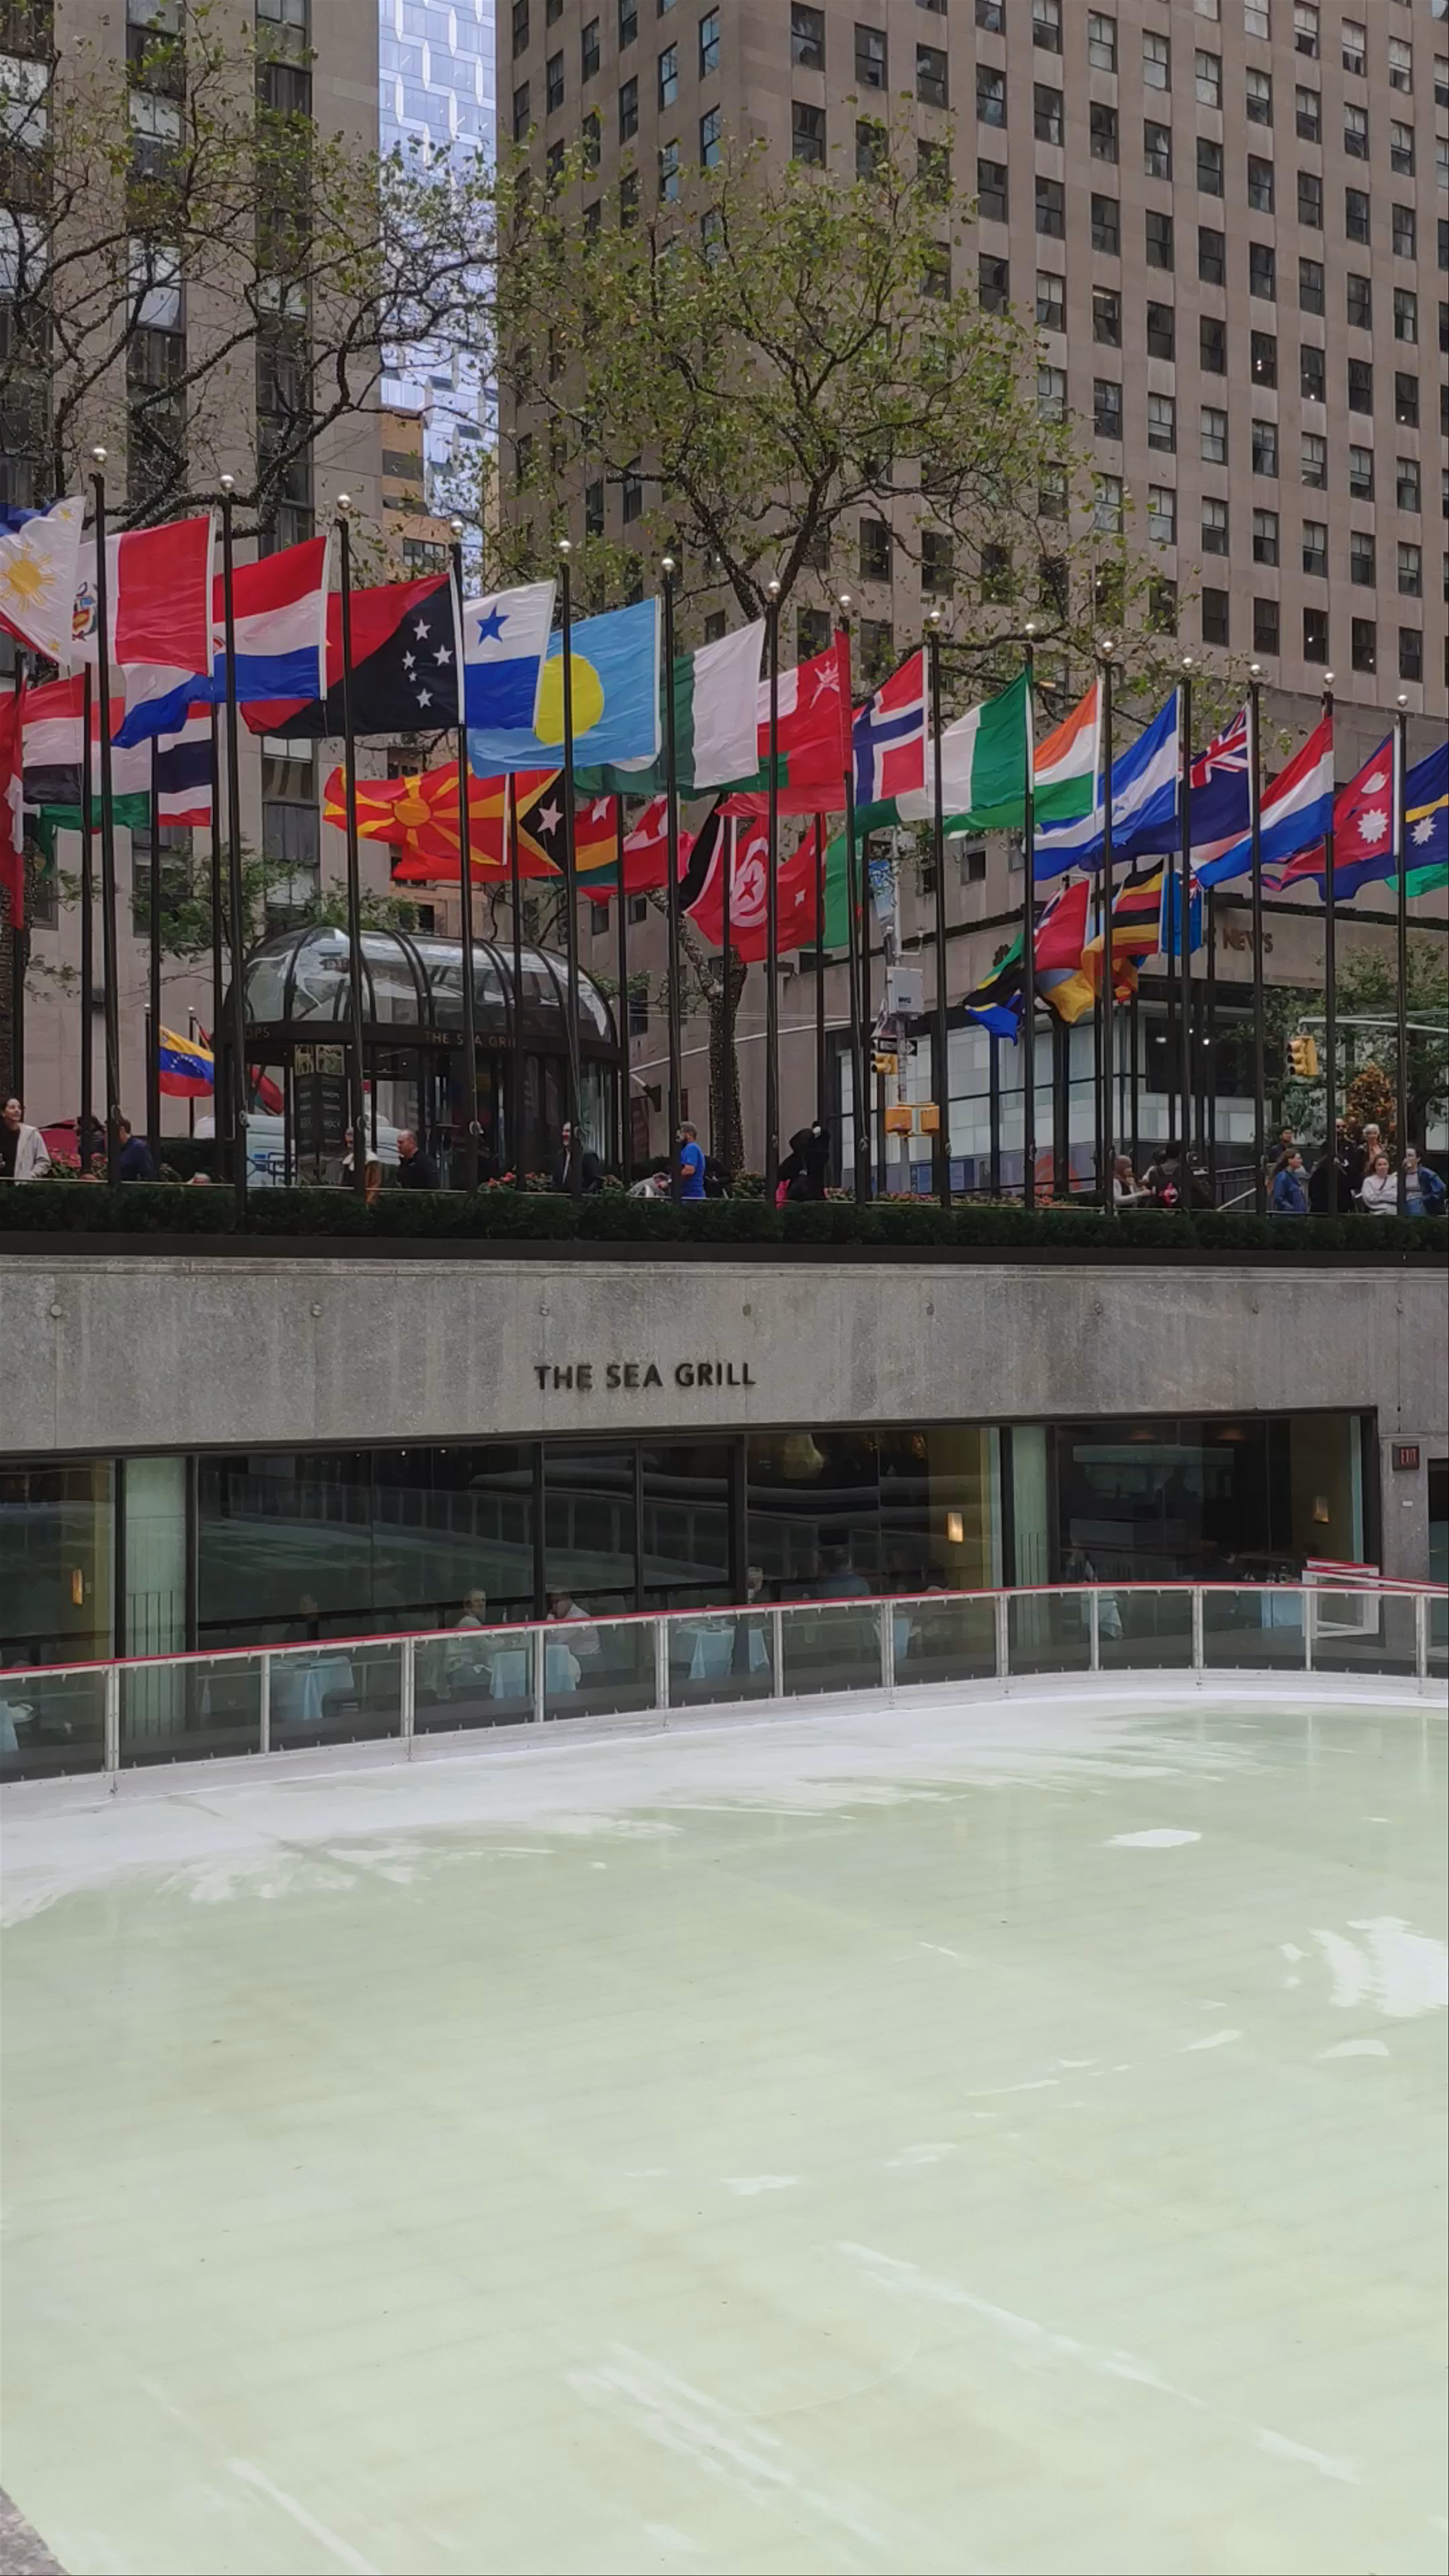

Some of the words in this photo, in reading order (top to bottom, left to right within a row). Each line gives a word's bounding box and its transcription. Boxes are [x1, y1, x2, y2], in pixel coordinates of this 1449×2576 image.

[245, 1026, 270, 1039] OPS
[425, 1031, 450, 1044] THE
[456, 1033, 483, 1046] SA
[489, 1036, 515, 1048] GRI
[534, 1365, 592, 1390] THE
[606, 1363, 663, 1388] SEA
[675, 1362, 756, 1387] GRILL
[1401, 1448, 1417, 1464] EXIT
